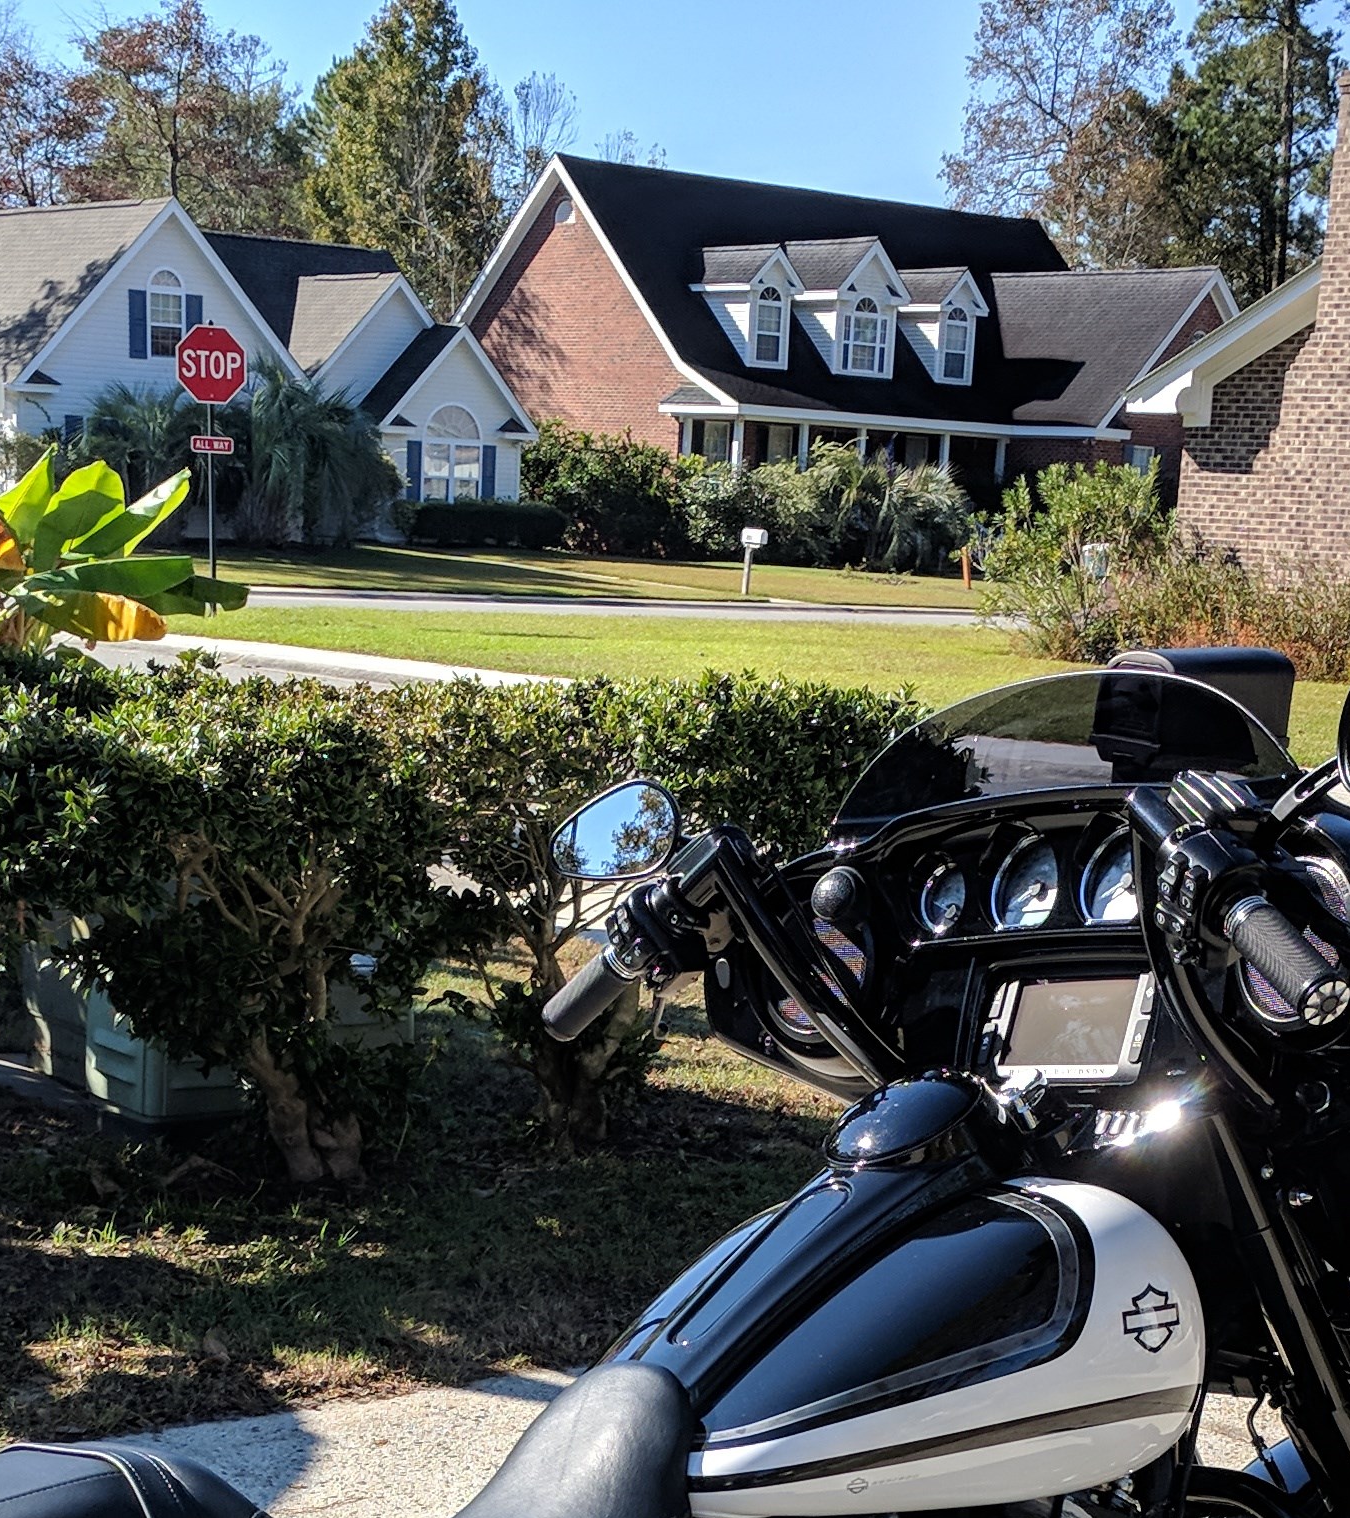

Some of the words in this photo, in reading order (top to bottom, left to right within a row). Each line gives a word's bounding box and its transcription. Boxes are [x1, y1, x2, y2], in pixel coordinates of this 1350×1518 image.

[181, 349, 241, 379] STOP
[195, 439, 211, 450] ALL
[212, 441, 230, 450] WAY
